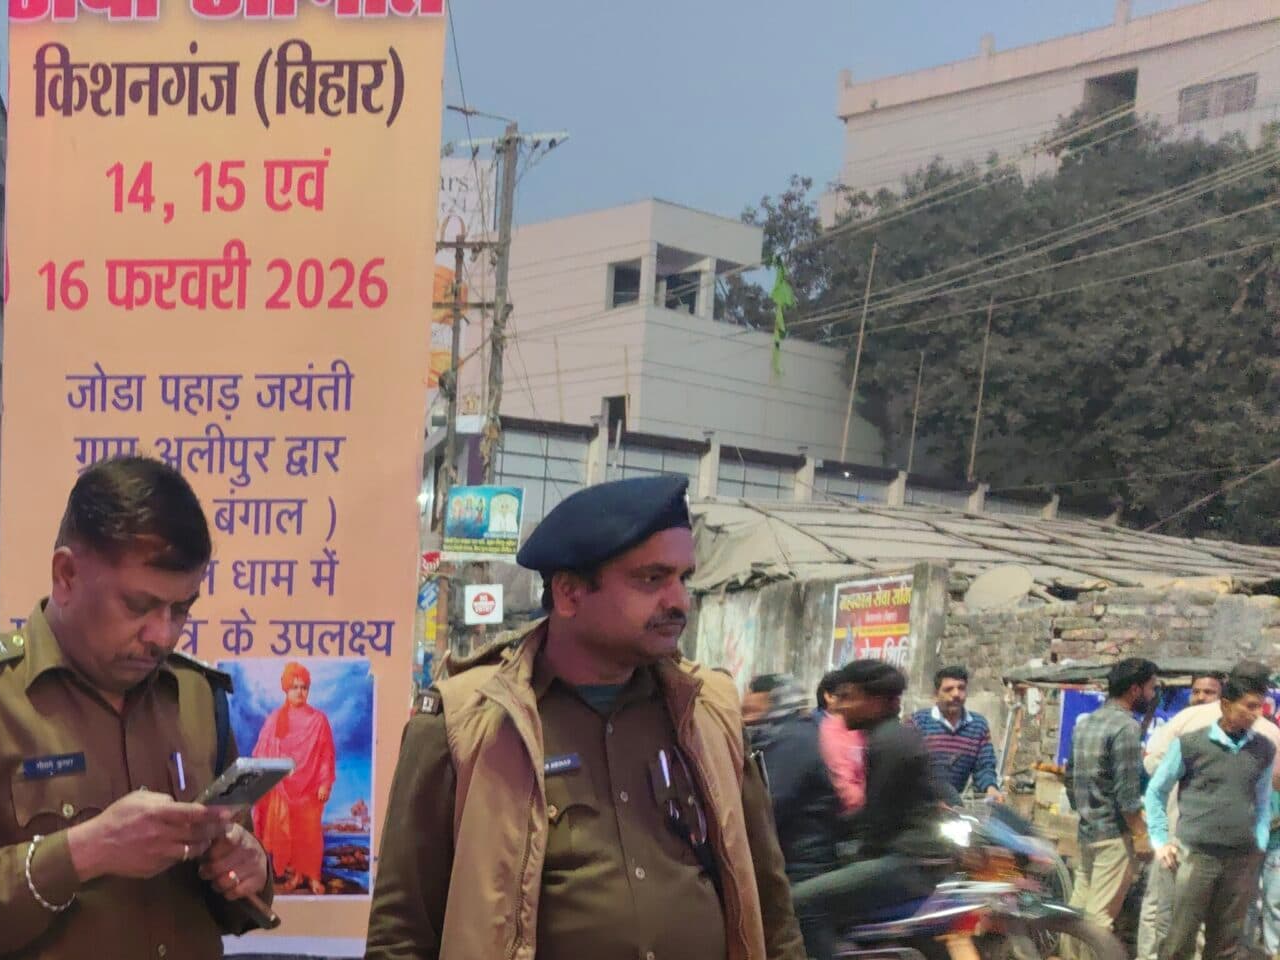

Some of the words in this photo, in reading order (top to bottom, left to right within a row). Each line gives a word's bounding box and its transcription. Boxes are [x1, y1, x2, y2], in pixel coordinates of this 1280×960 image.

[33, 41, 240, 118] किशनगंज
[254, 39, 406, 127] (बिहार)
[105, 160, 175, 224] 14,
[194, 160, 246, 212] 15
[264, 148, 332, 212] एवं
[38, 259, 89, 311] 16
[106, 239, 252, 311] फरवरी
[265, 257, 390, 310] 2026
[159, 374, 243, 421] पहाड़
[255, 359, 356, 412] जयंती
[155, 424, 276, 487] अलीपुर
[285, 437, 347, 477] द्वार
[213, 488, 308, 536] बंगाल
[232, 559, 296, 597] धाम
[311, 548, 340, 597] में
[221, 609, 254, 657] के
[270, 619, 396, 658] उपलक्ष्य
